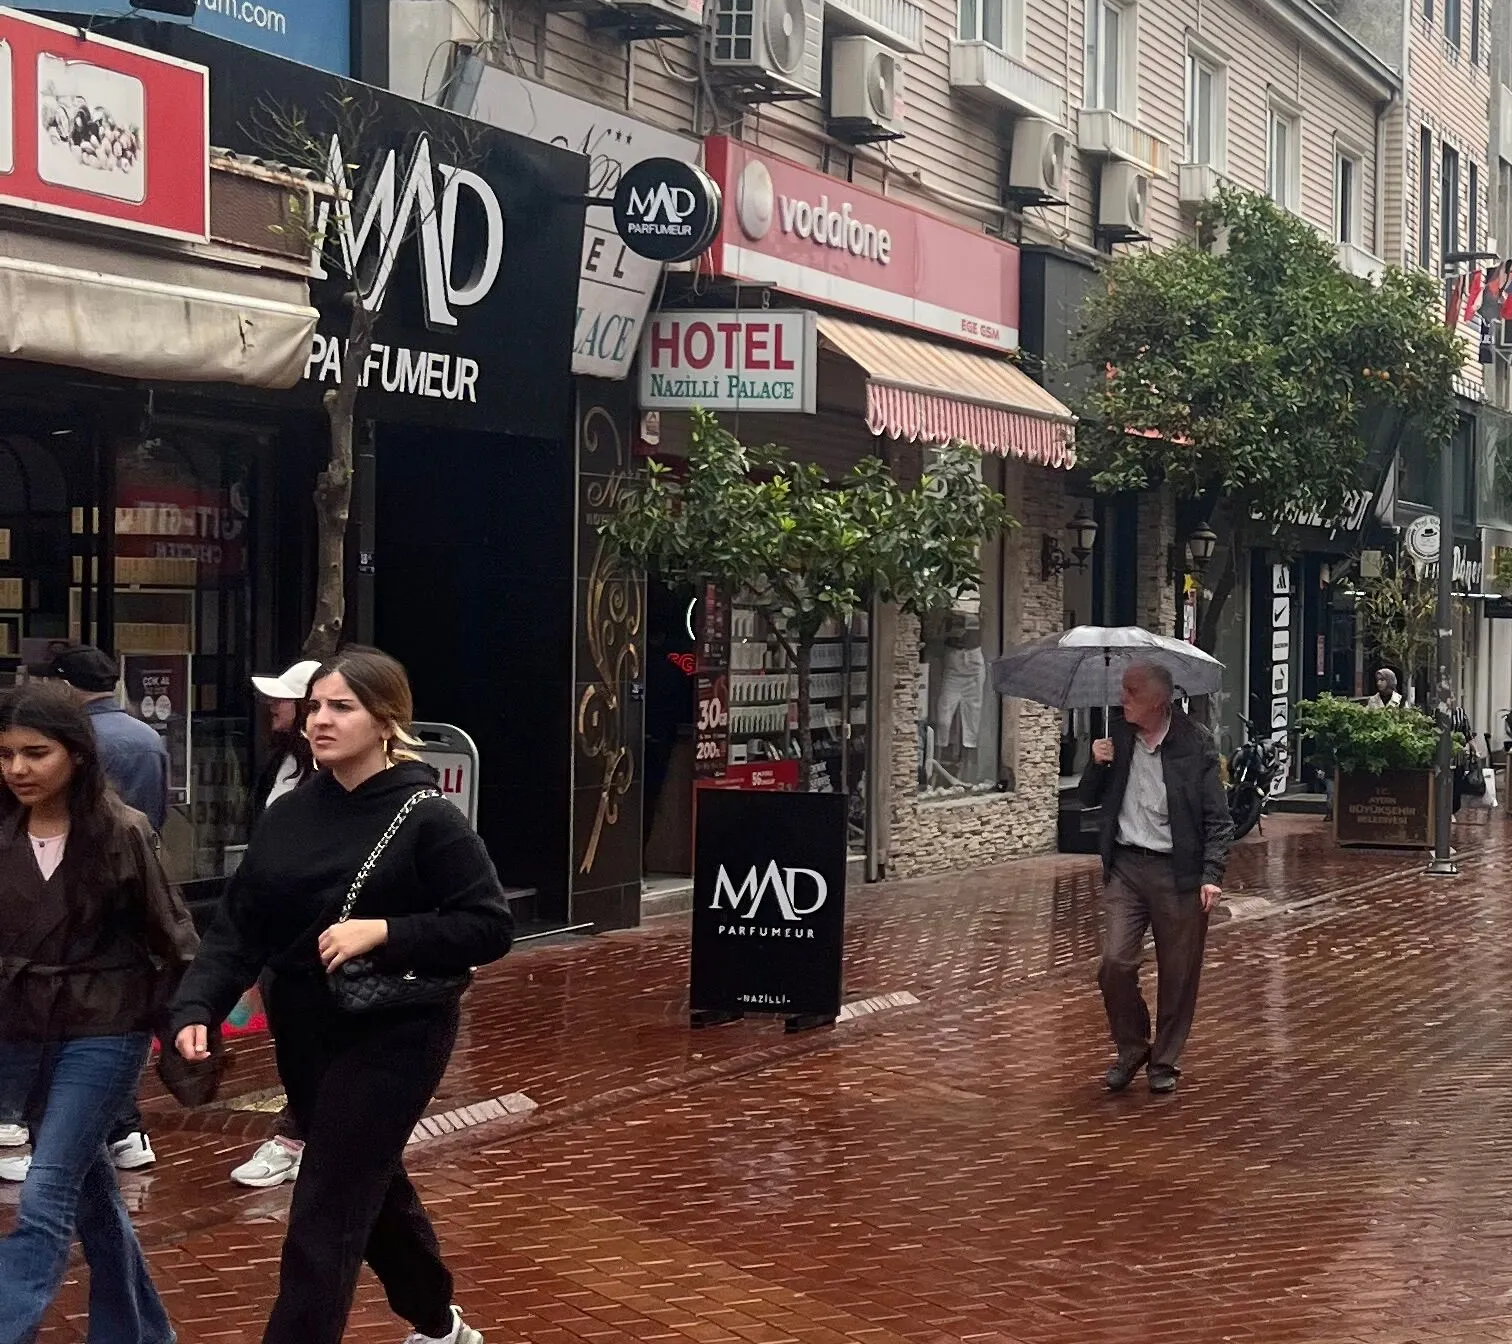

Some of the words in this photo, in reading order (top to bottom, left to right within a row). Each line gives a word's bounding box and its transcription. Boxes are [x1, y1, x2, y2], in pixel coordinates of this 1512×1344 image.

[626, 181, 696, 223] MAD
[313, 130, 504, 327] MAD
[627, 222, 693, 236] PARFUMEUR
[778, 191, 892, 267] vodafone
[651, 321, 795, 371] HOTEL
[650, 372, 720, 399] NAZİLLİ
[727, 373, 795, 400] PALACE
[708, 859, 828, 921] MAD
[718, 925, 815, 939] PARFUMEUR
